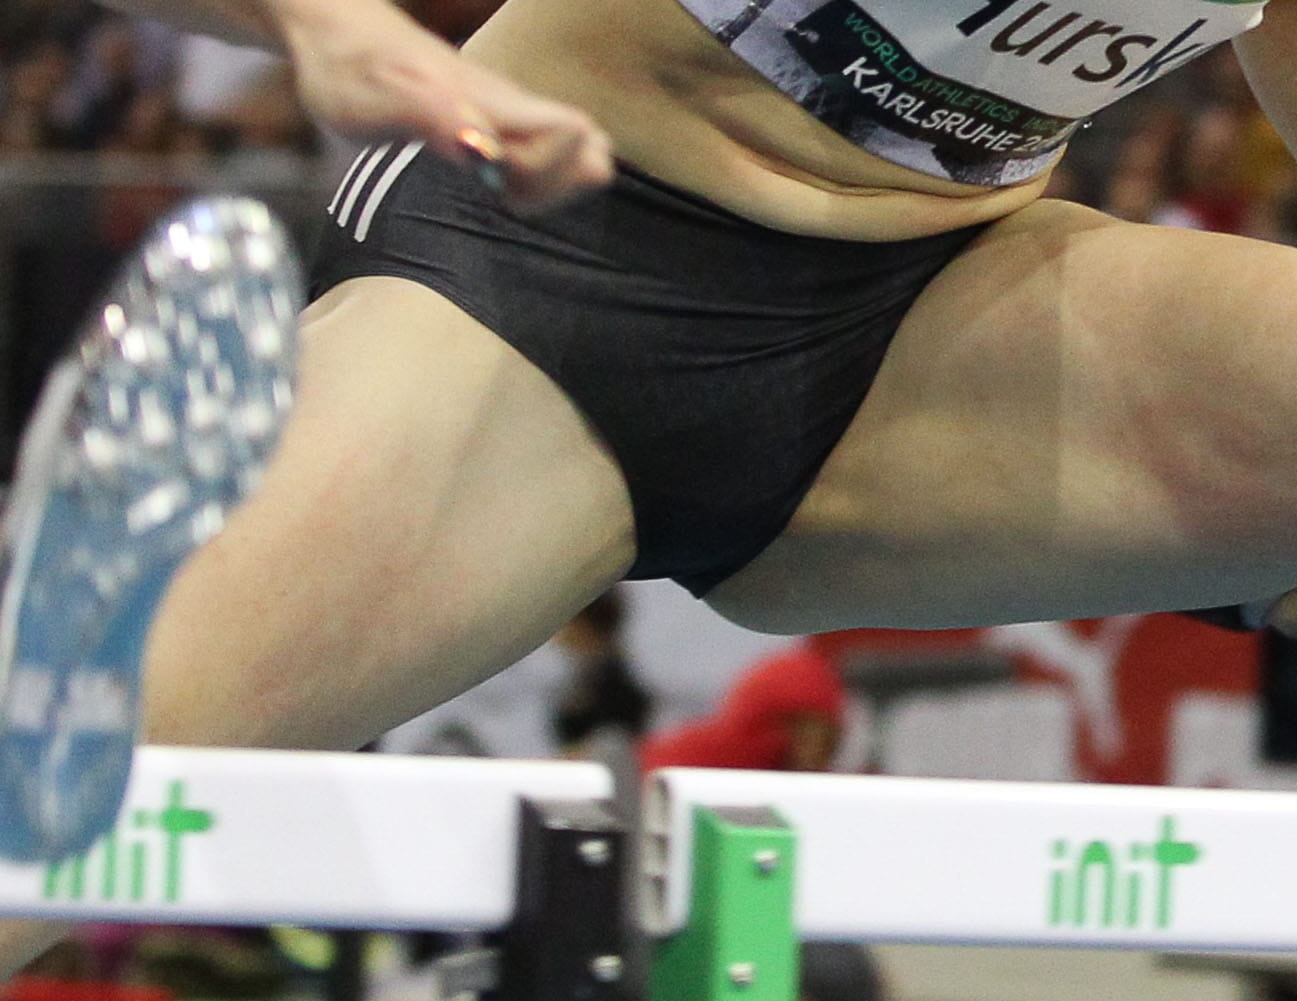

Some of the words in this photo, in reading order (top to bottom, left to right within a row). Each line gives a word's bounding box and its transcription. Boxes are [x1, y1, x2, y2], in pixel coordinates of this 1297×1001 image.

[842, 56, 1023, 152] KARLSRUHE
[844, 12, 918, 83] WORLD
[913, 80, 1020, 123] ATHLETICS
[1045, 814, 1202, 928] init
